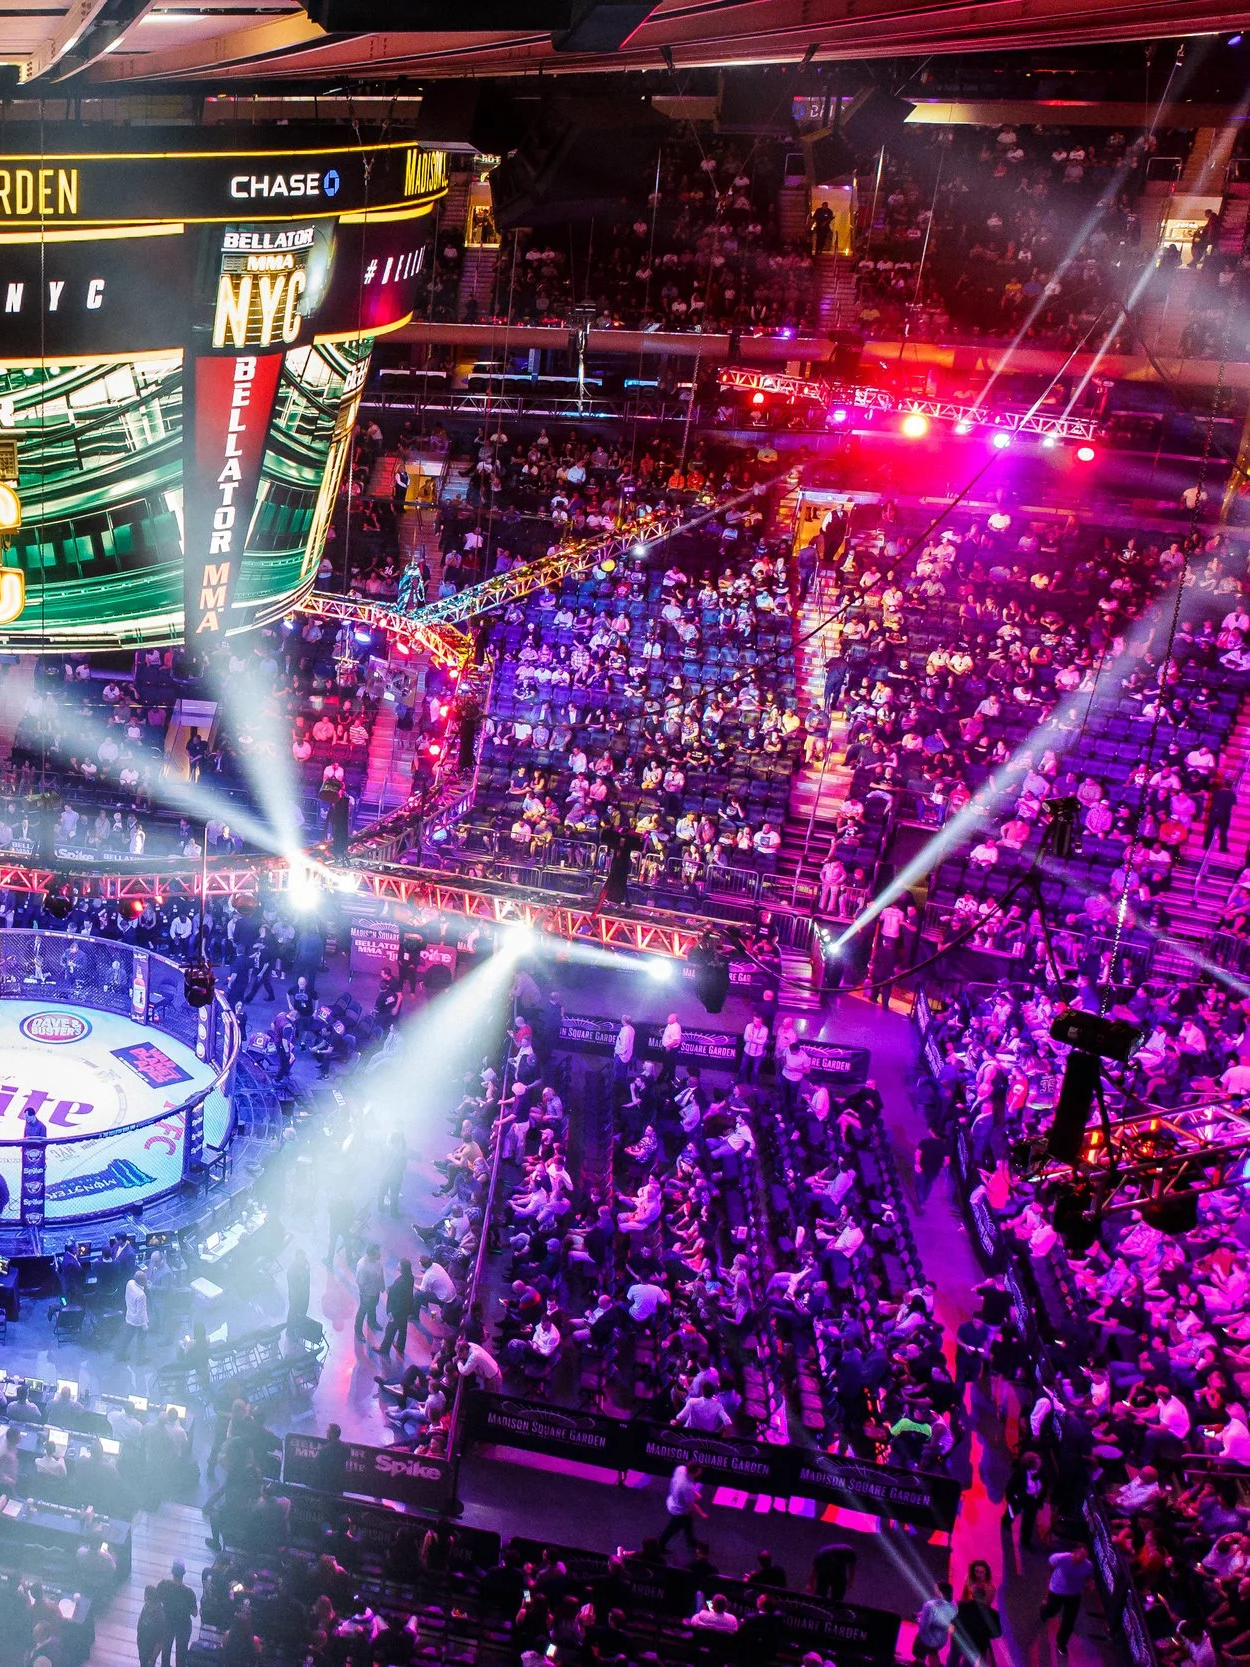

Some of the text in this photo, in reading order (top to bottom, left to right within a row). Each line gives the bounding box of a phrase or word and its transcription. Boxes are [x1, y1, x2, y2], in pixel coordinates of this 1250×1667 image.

[230, 173, 321, 198] CHASE
[224, 227, 315, 249] BELLATOR
[247, 254, 294, 271] MMA
[212, 268, 307, 349] NYC
[195, 356, 258, 635] BELLATOR MMA
[357, 945, 383, 955] MMA
[737, 971, 751, 983] GAR
[32, 1015, 70, 1029] DAVE
[567, 1028, 595, 1041] SQUARE
[680, 1043, 736, 1058] SQUARE GARDEN
[821, 1058, 851, 1071] GARDEN
[23, 1166, 44, 1176] Spike
[23, 1197, 44, 1207] Spike
[487, 1411, 607, 1448] MADISON SQUARE GARDEN
[646, 1441, 770, 1476] MADISON SQUARE GARDEN
[374, 1454, 443, 1481] Spike
[800, 1466, 931, 1506] MADISON SQUARE GARDEN
[629, 1583, 665, 1599] ARDEN
[823, 1619, 868, 1642] GARDEN
